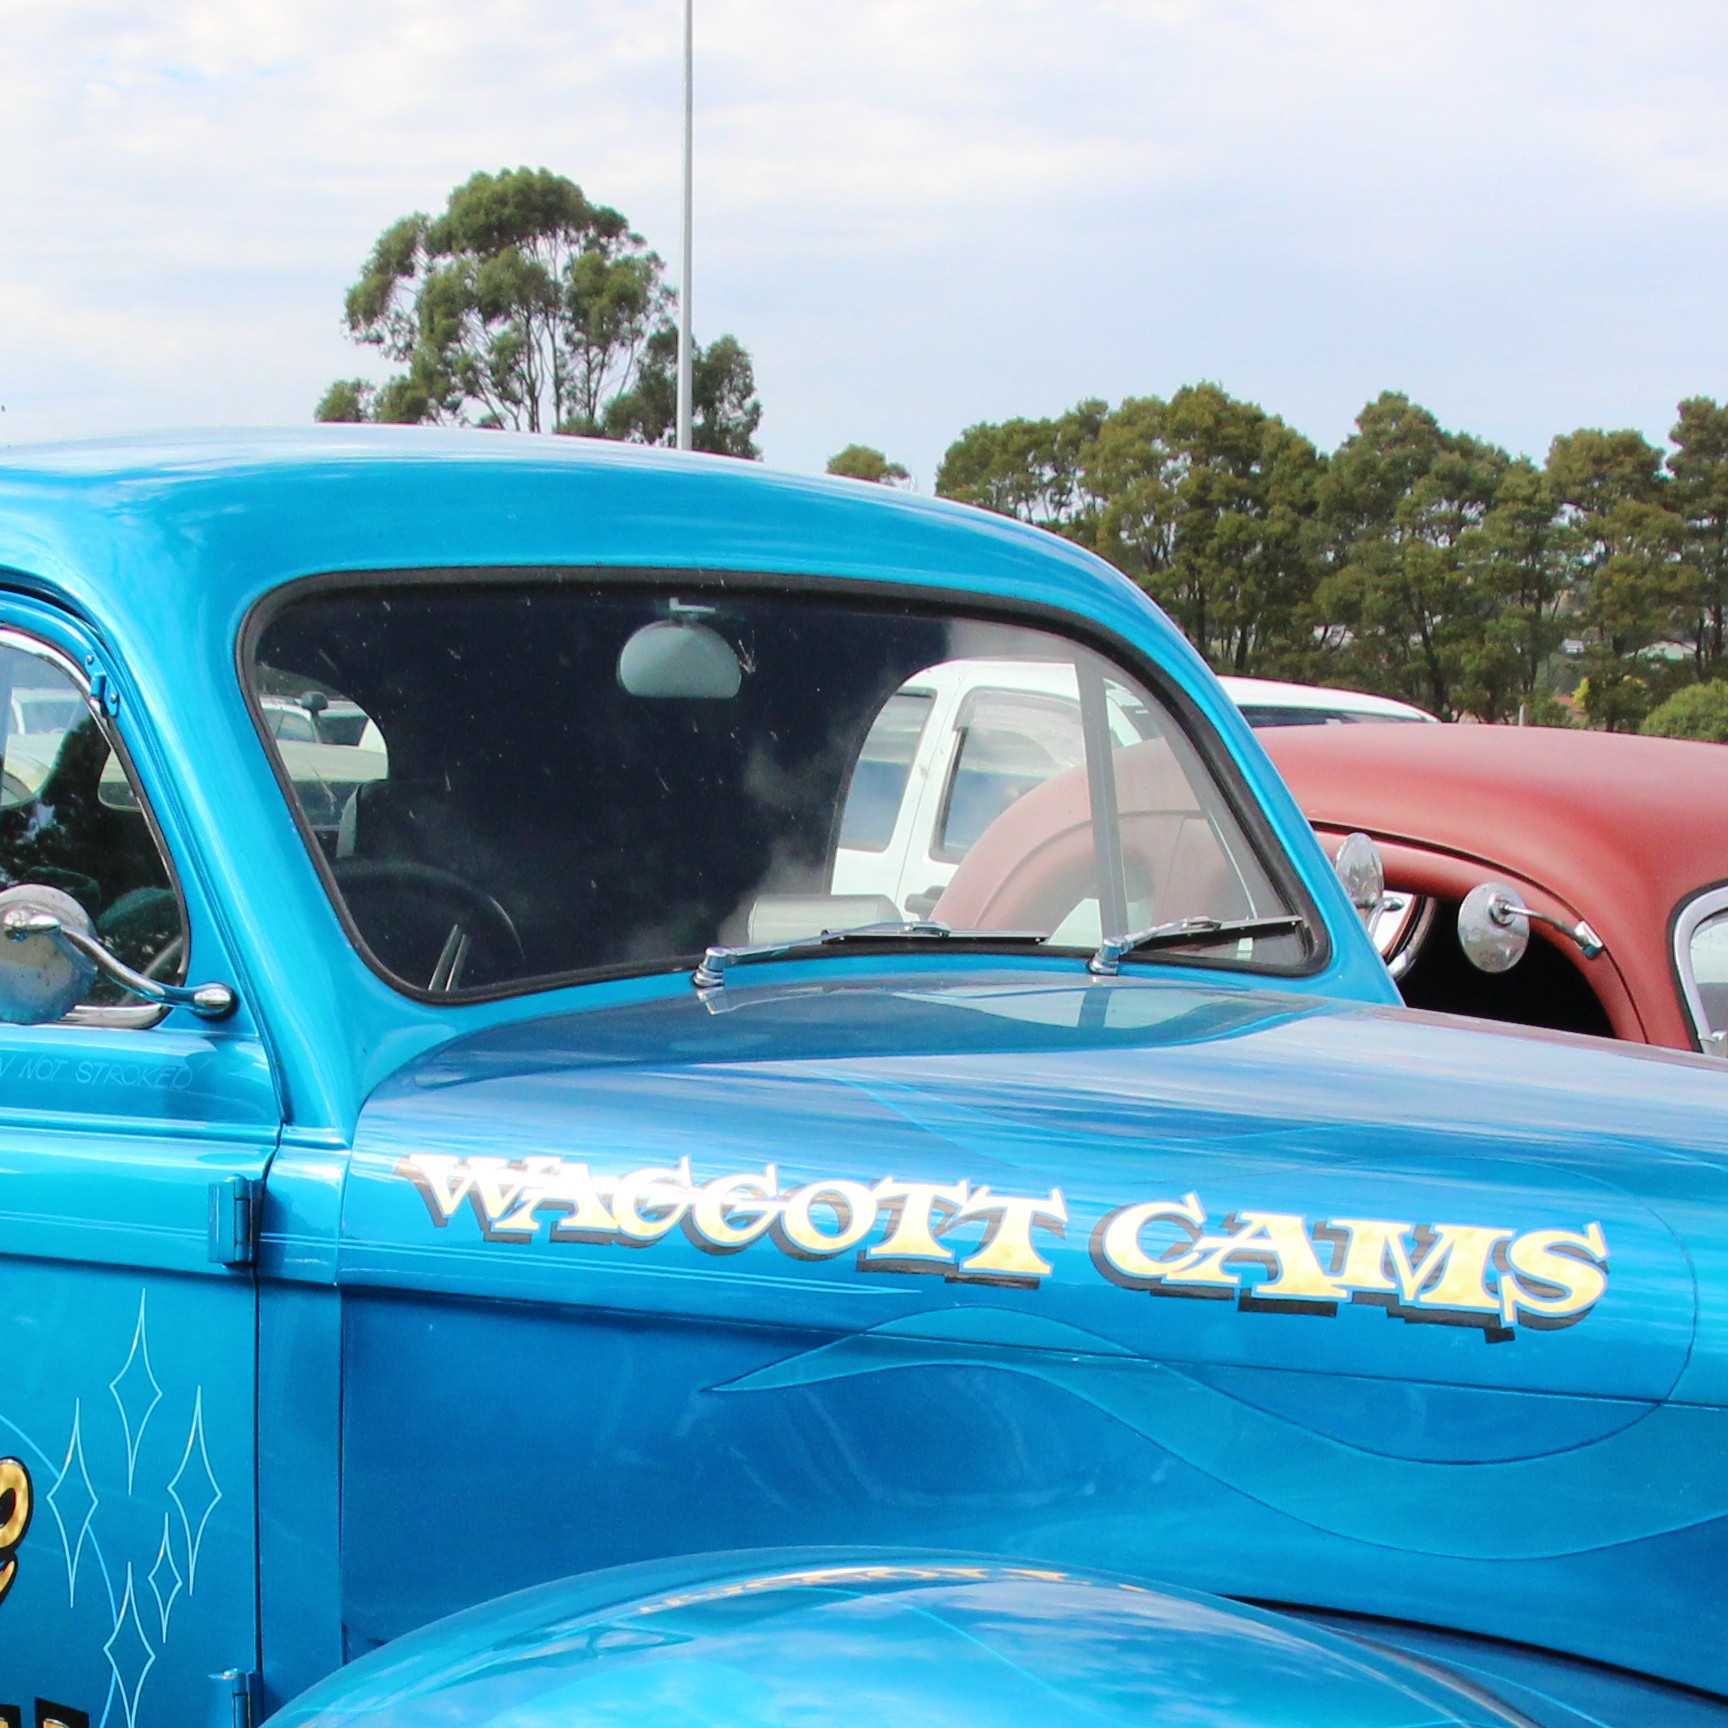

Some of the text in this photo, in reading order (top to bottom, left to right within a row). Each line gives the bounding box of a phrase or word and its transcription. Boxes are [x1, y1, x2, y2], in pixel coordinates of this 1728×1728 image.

[18, 1054, 68, 1082] NOT
[395, 1155, 1608, 1342] WAGGOTT CAMS
